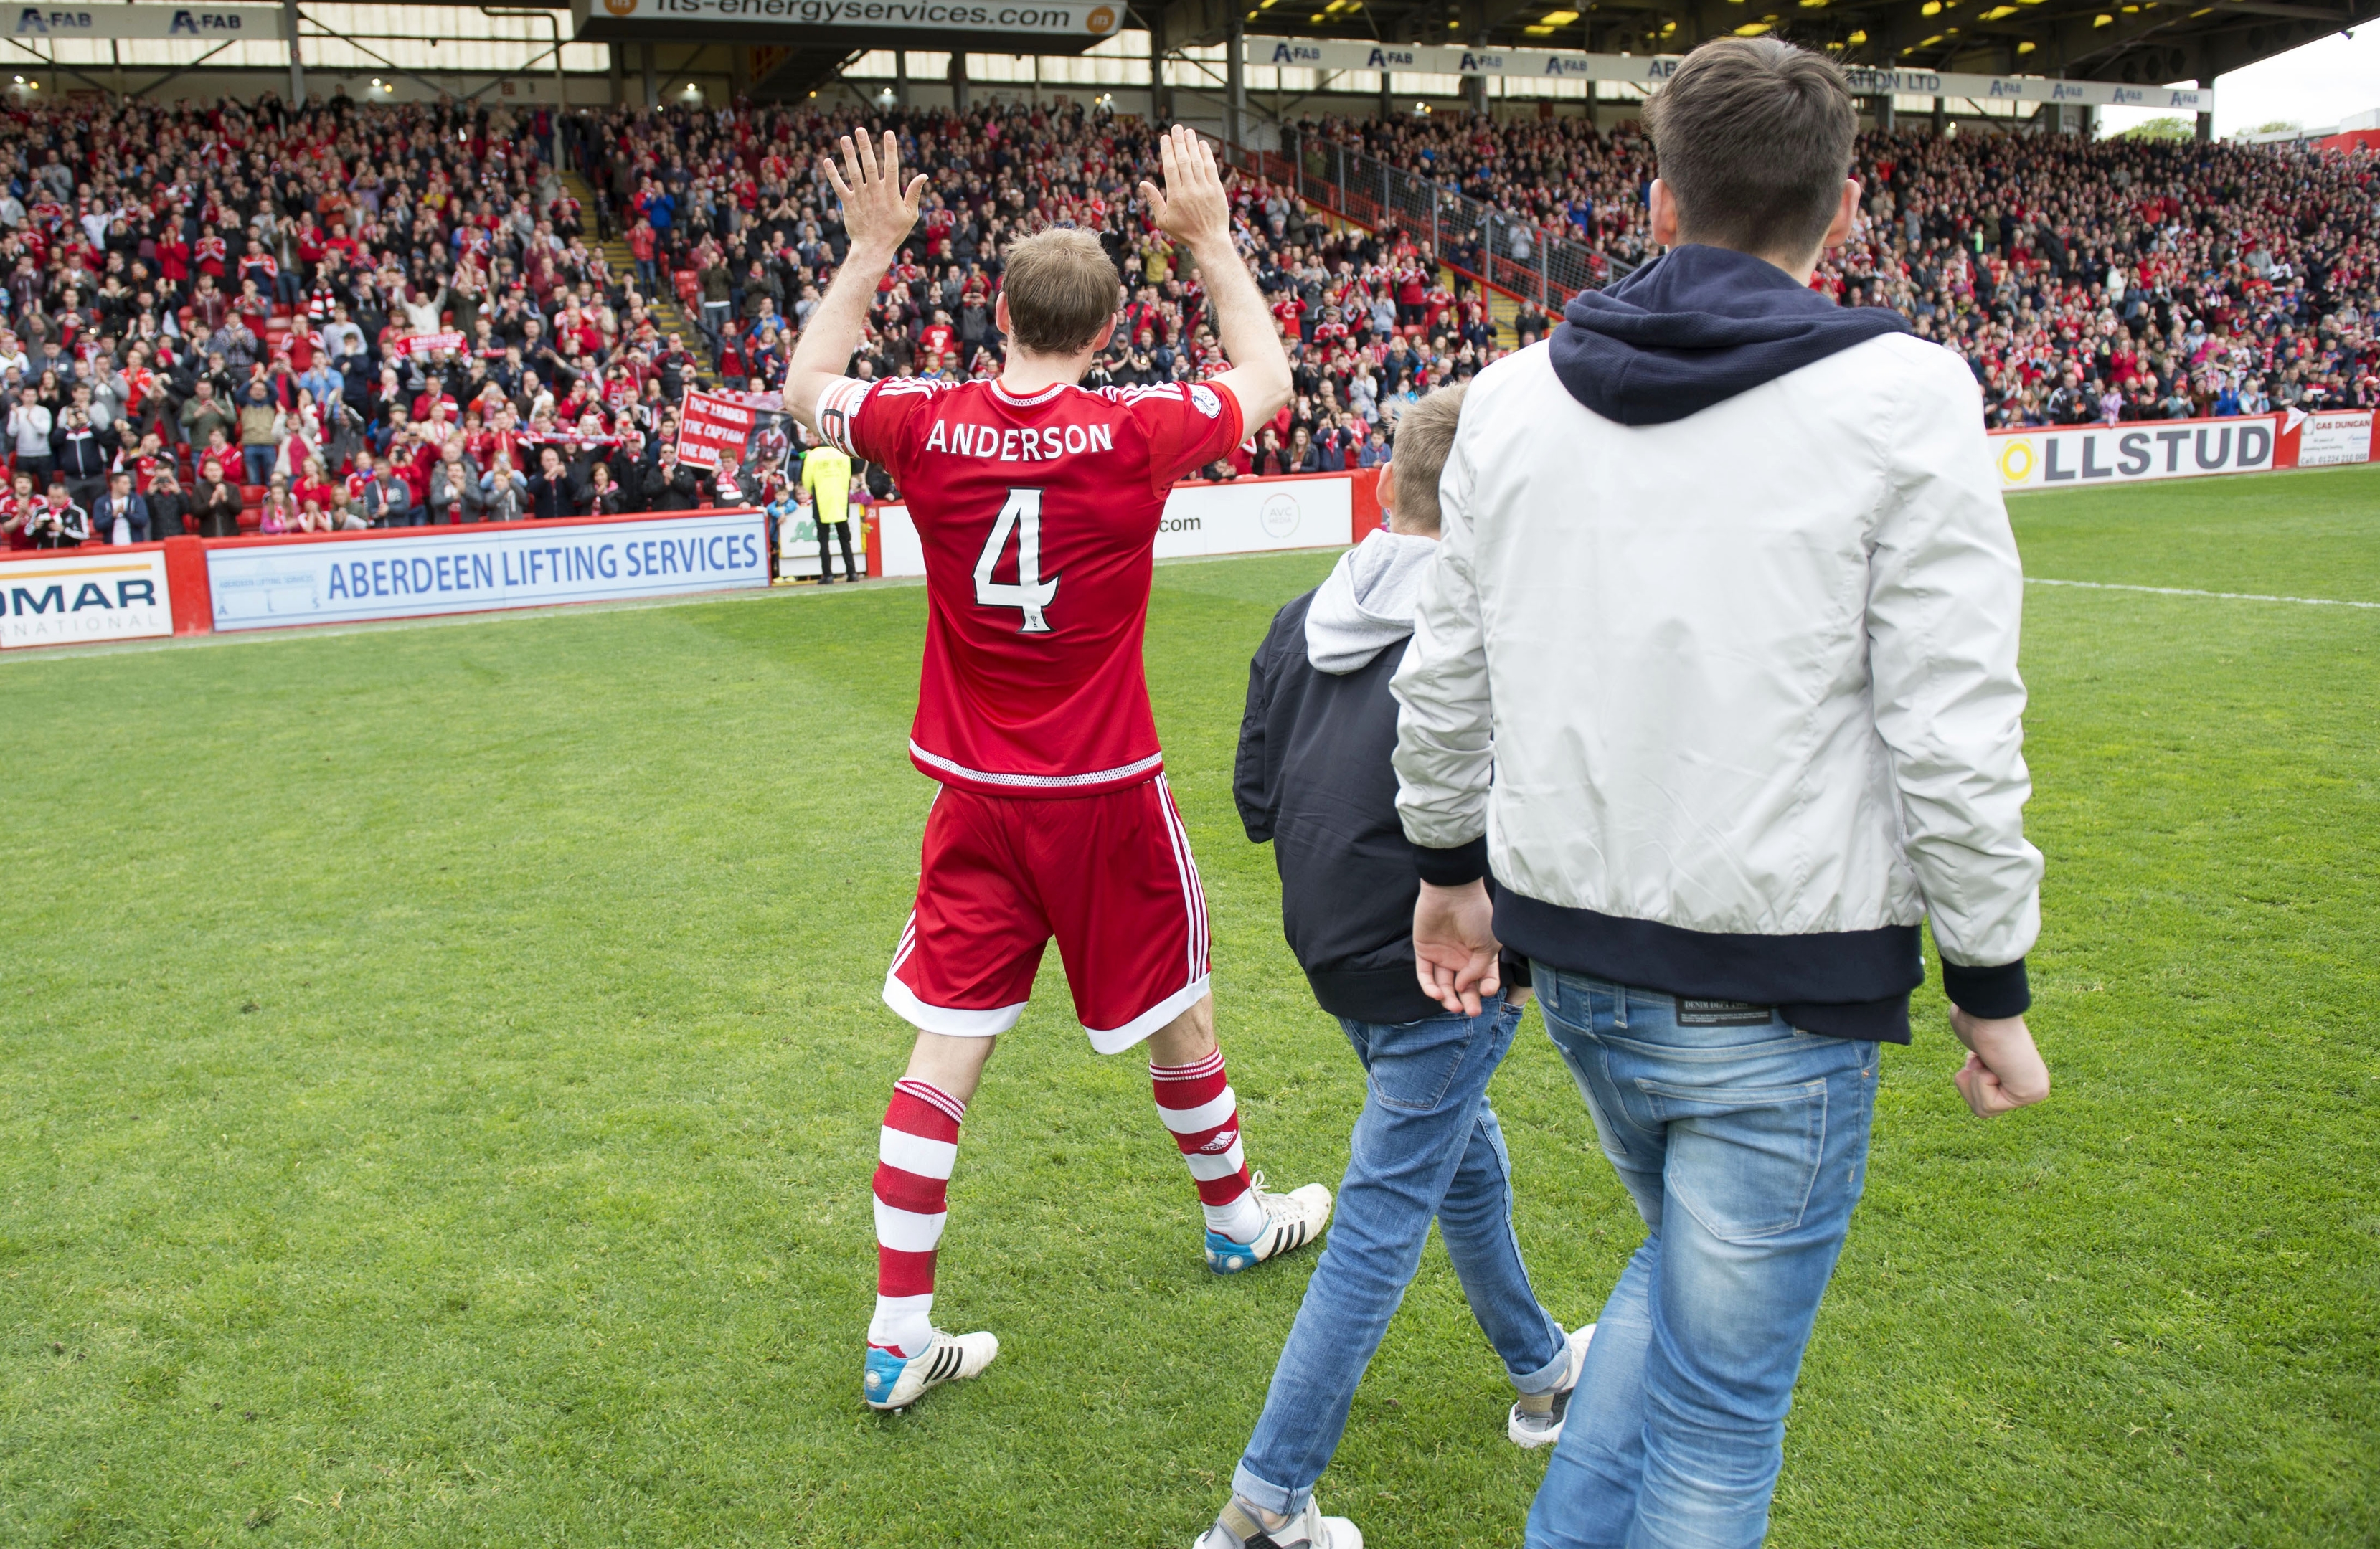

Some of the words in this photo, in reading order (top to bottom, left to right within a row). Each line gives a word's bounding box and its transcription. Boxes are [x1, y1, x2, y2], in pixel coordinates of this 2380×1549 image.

[1909, 74, 1940, 91] LTD
[689, 395, 710, 412] THE
[709, 402, 748, 424] LEADER
[684, 418, 704, 435] THE
[704, 424, 745, 445] CAPTAIN
[2335, 419, 2370, 430] DUNCAN
[681, 442, 699, 458] THE
[925, 420, 1113, 461] ANDERSON
[328, 552, 494, 600] ABERDEEN
[502, 544, 618, 586] LIFTING
[625, 534, 758, 578] SERVICES
[971, 486, 1064, 634] 4
[0, 579, 156, 617] MAR
[1200, 1129, 1237, 1151] adidas
